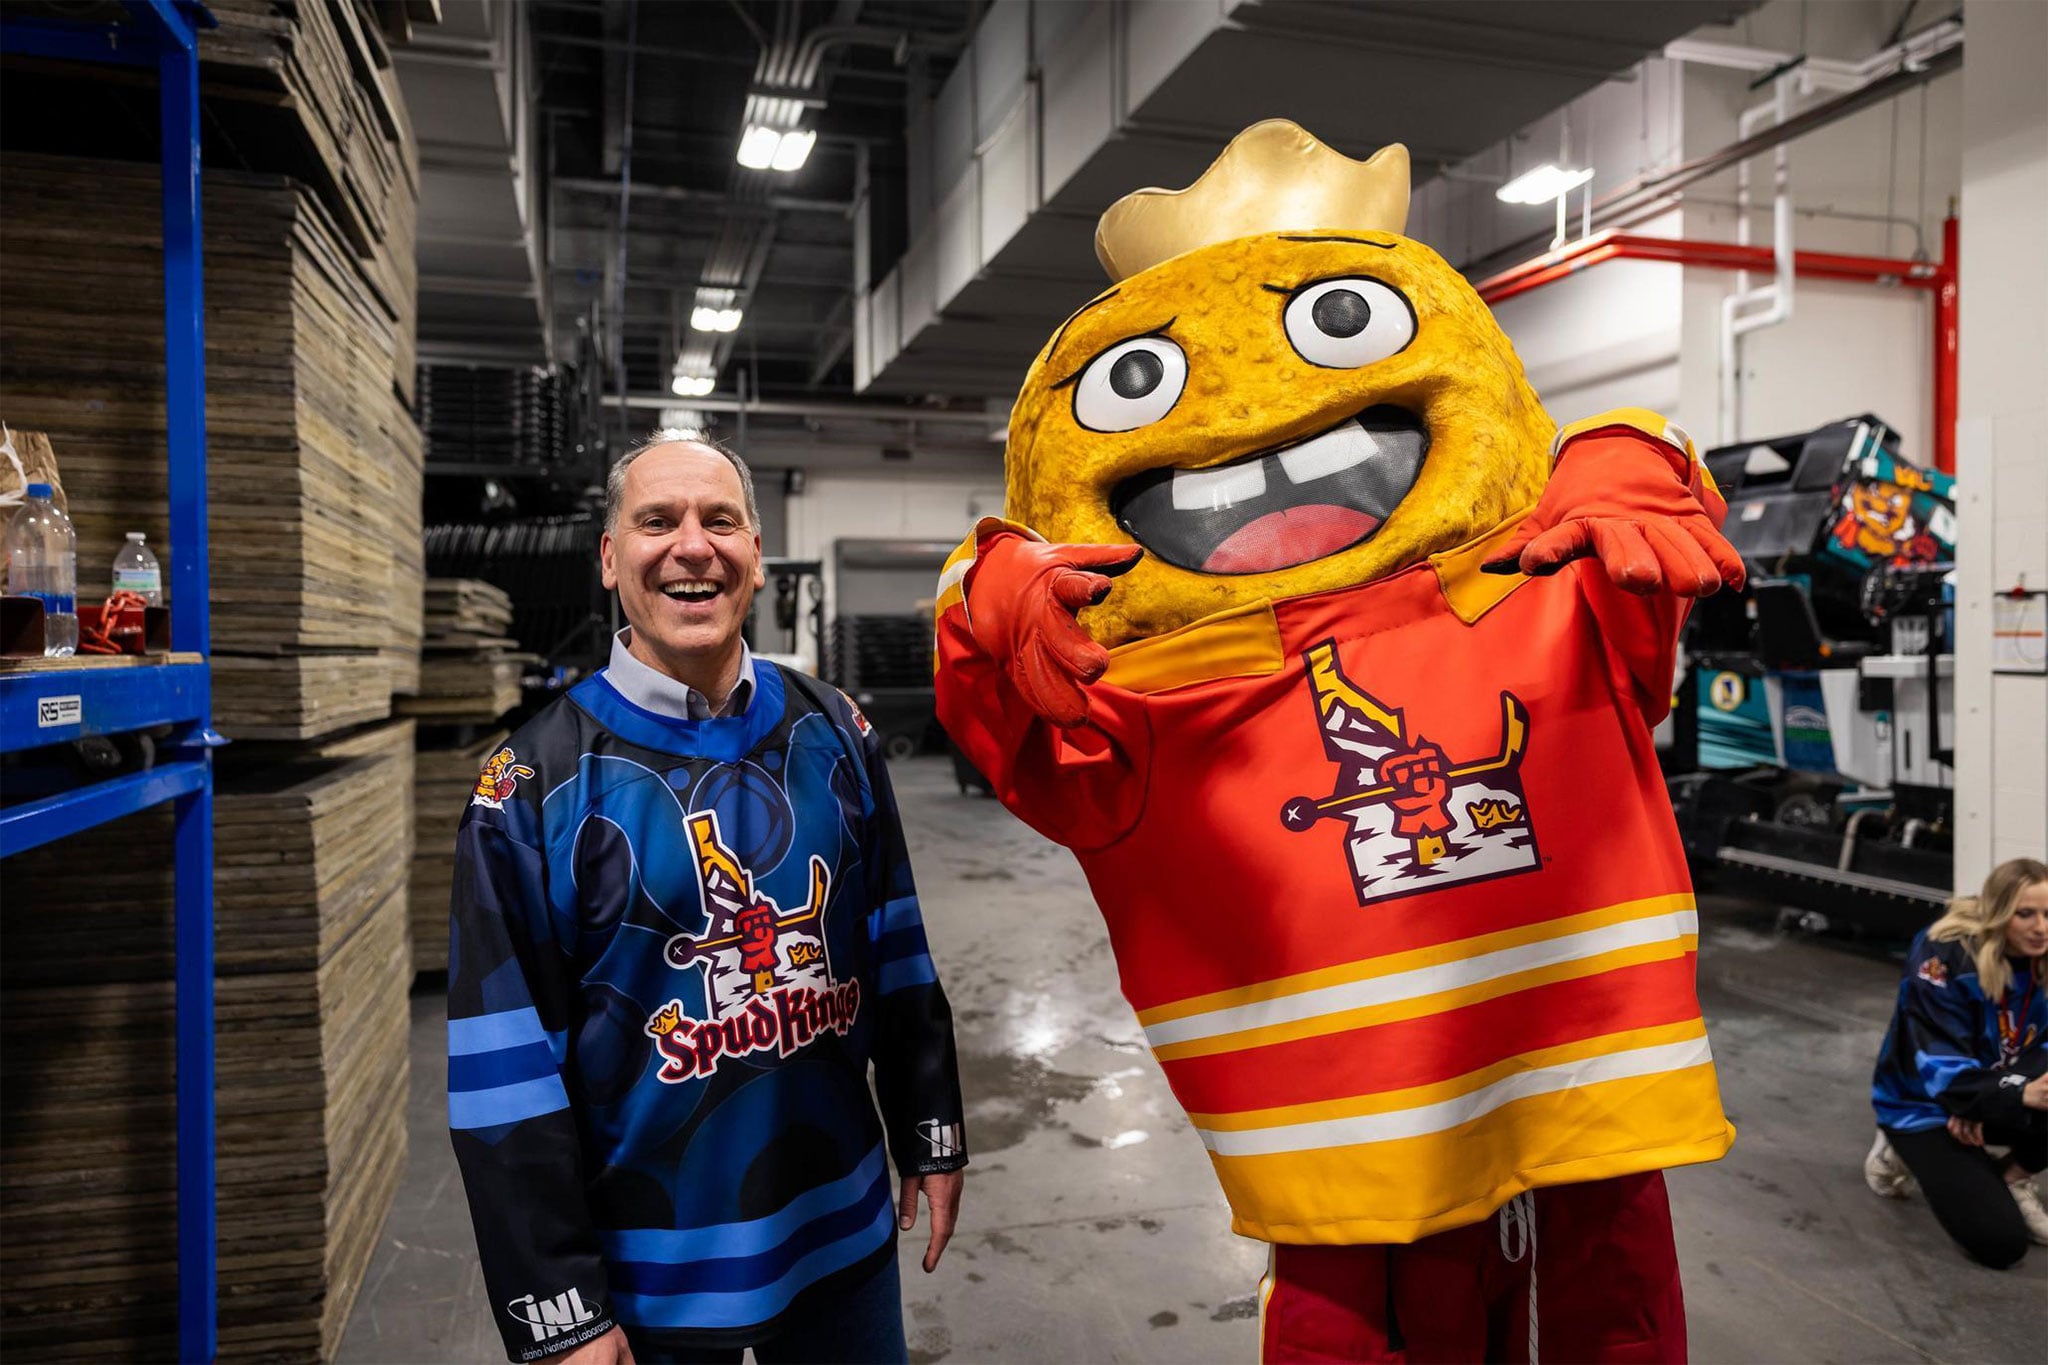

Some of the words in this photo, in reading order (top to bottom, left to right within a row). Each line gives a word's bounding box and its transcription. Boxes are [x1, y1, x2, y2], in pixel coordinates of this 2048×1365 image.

[521, 1346, 542, 1360] Idaho
[543, 1332, 578, 1354] National
[577, 1319, 613, 1341] Laboratory
